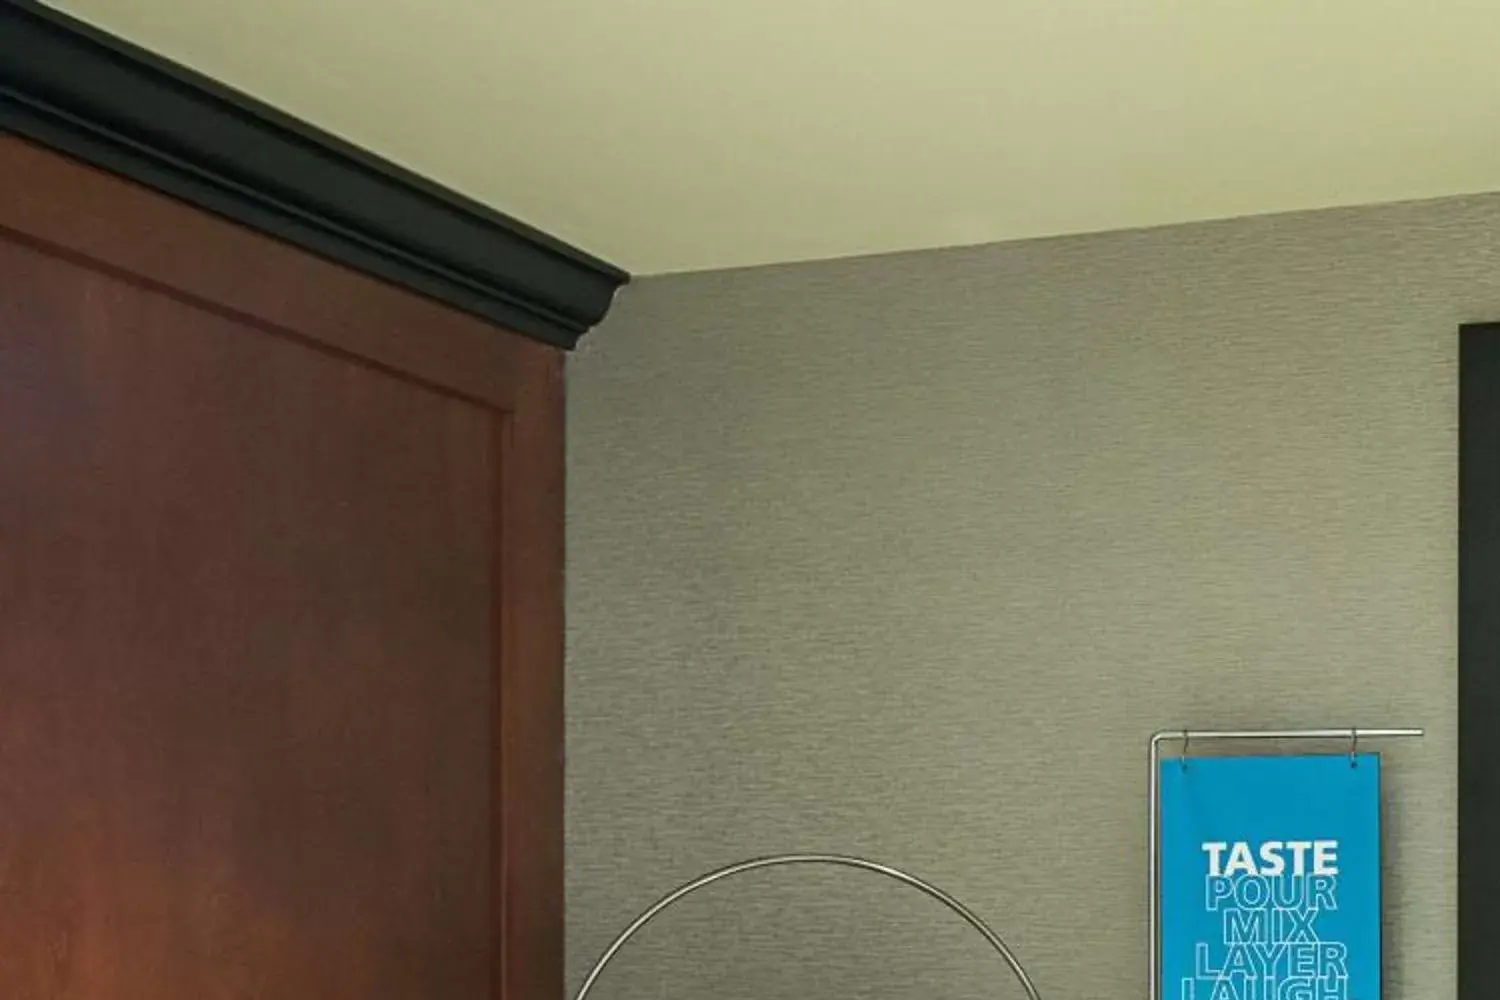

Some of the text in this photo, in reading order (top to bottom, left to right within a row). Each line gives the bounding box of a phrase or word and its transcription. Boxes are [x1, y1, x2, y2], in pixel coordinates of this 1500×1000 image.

[1202, 840, 1339, 876] TASTE
[1205, 873, 1338, 911] POUR
[1224, 908, 1319, 945] MIX
[1196, 942, 1349, 980] LAYER
